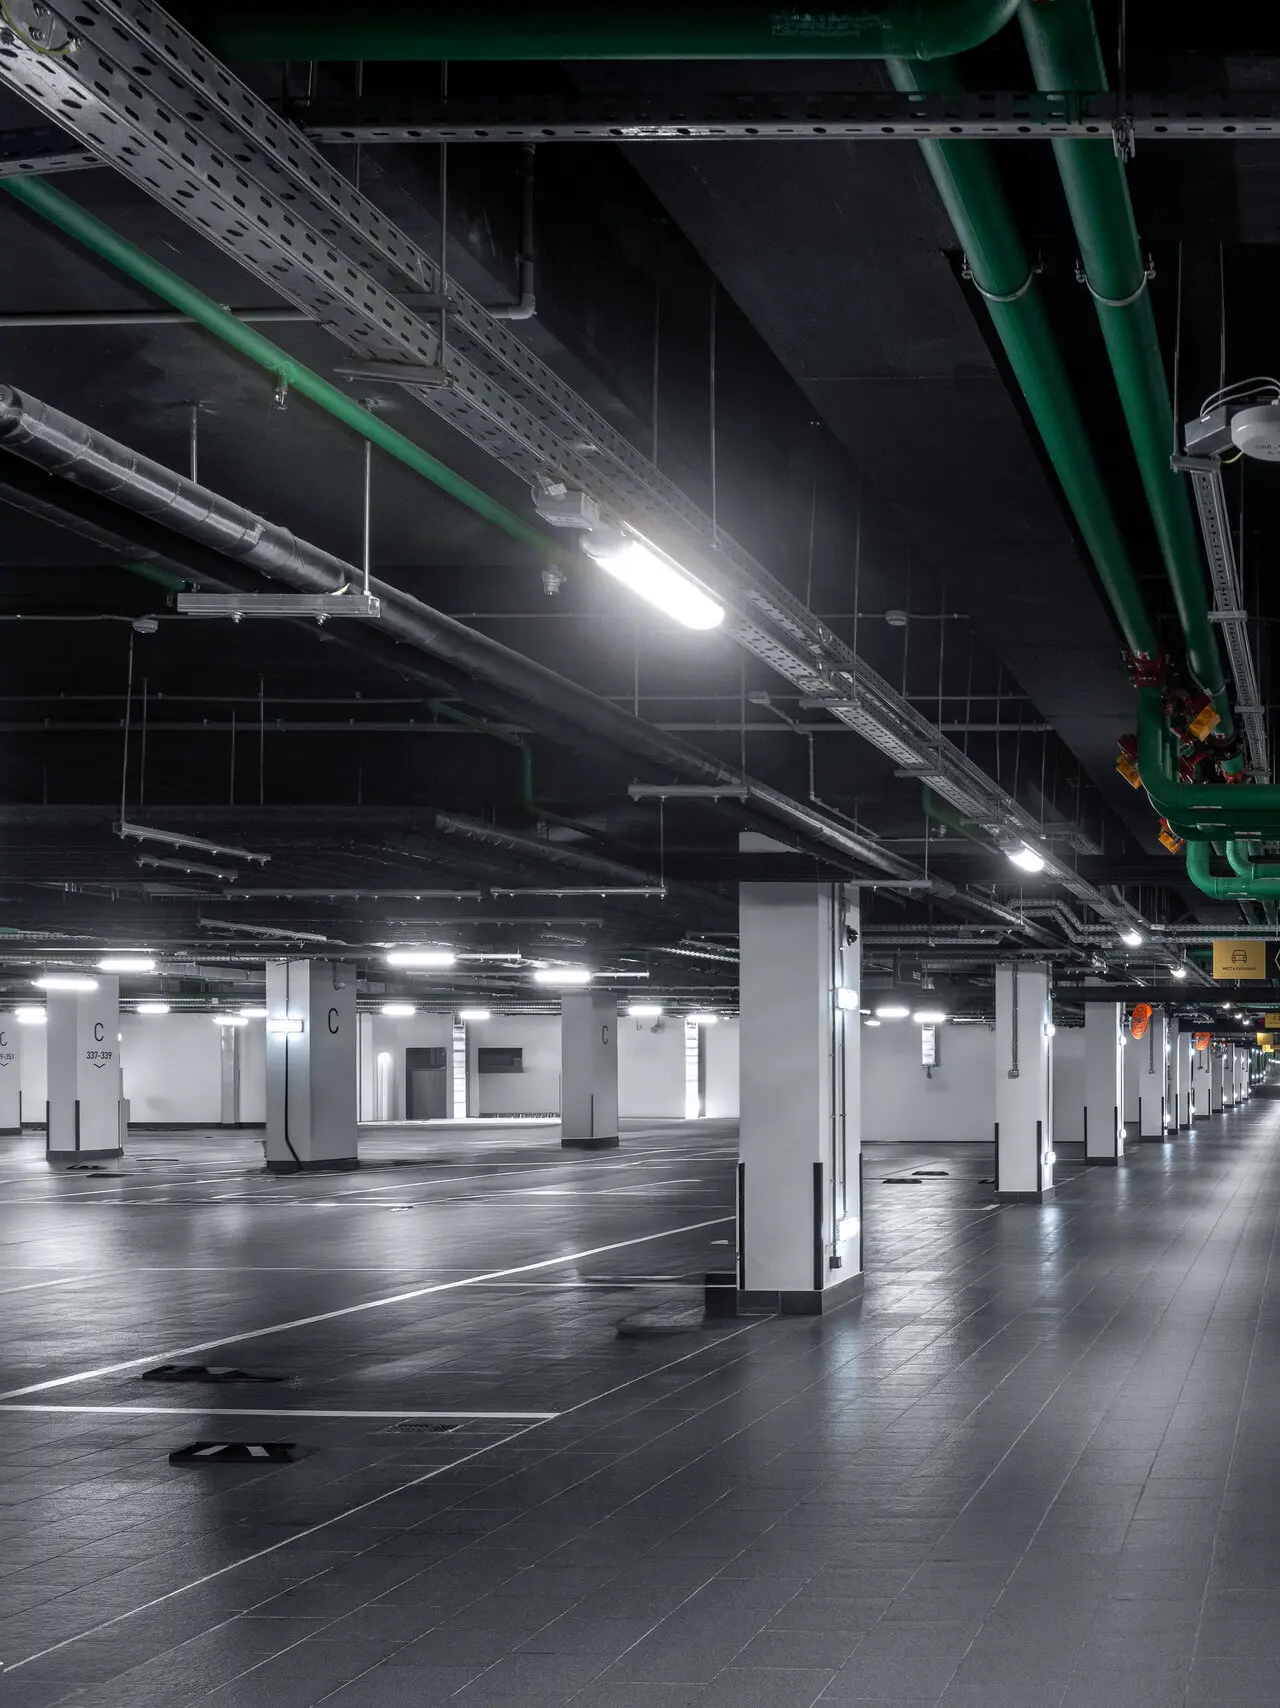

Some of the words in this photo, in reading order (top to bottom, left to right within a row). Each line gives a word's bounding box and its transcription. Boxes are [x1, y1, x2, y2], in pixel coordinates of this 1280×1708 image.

[328, 1008, 339, 1034] C
[94, 1022, 104, 1042] C
[602, 1025, 608, 1045] C
